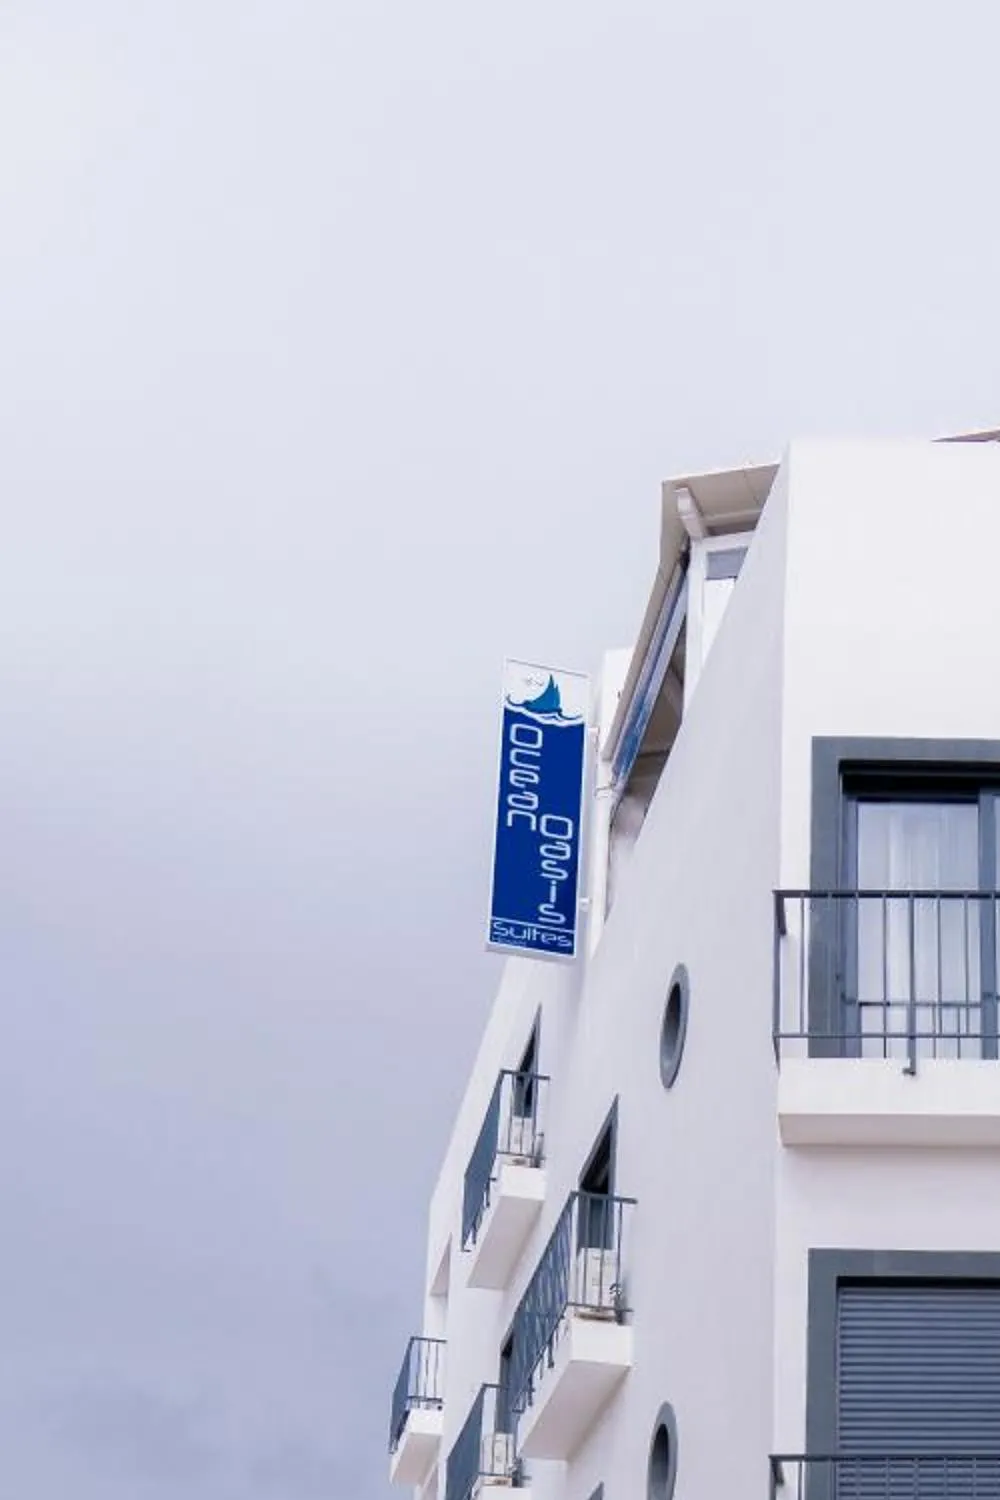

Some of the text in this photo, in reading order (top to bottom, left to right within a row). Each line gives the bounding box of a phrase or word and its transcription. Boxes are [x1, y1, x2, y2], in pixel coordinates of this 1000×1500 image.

[508, 723, 543, 831] Ocean
[539, 814, 573, 923] Oasis
[493, 921, 572, 947] Suites
